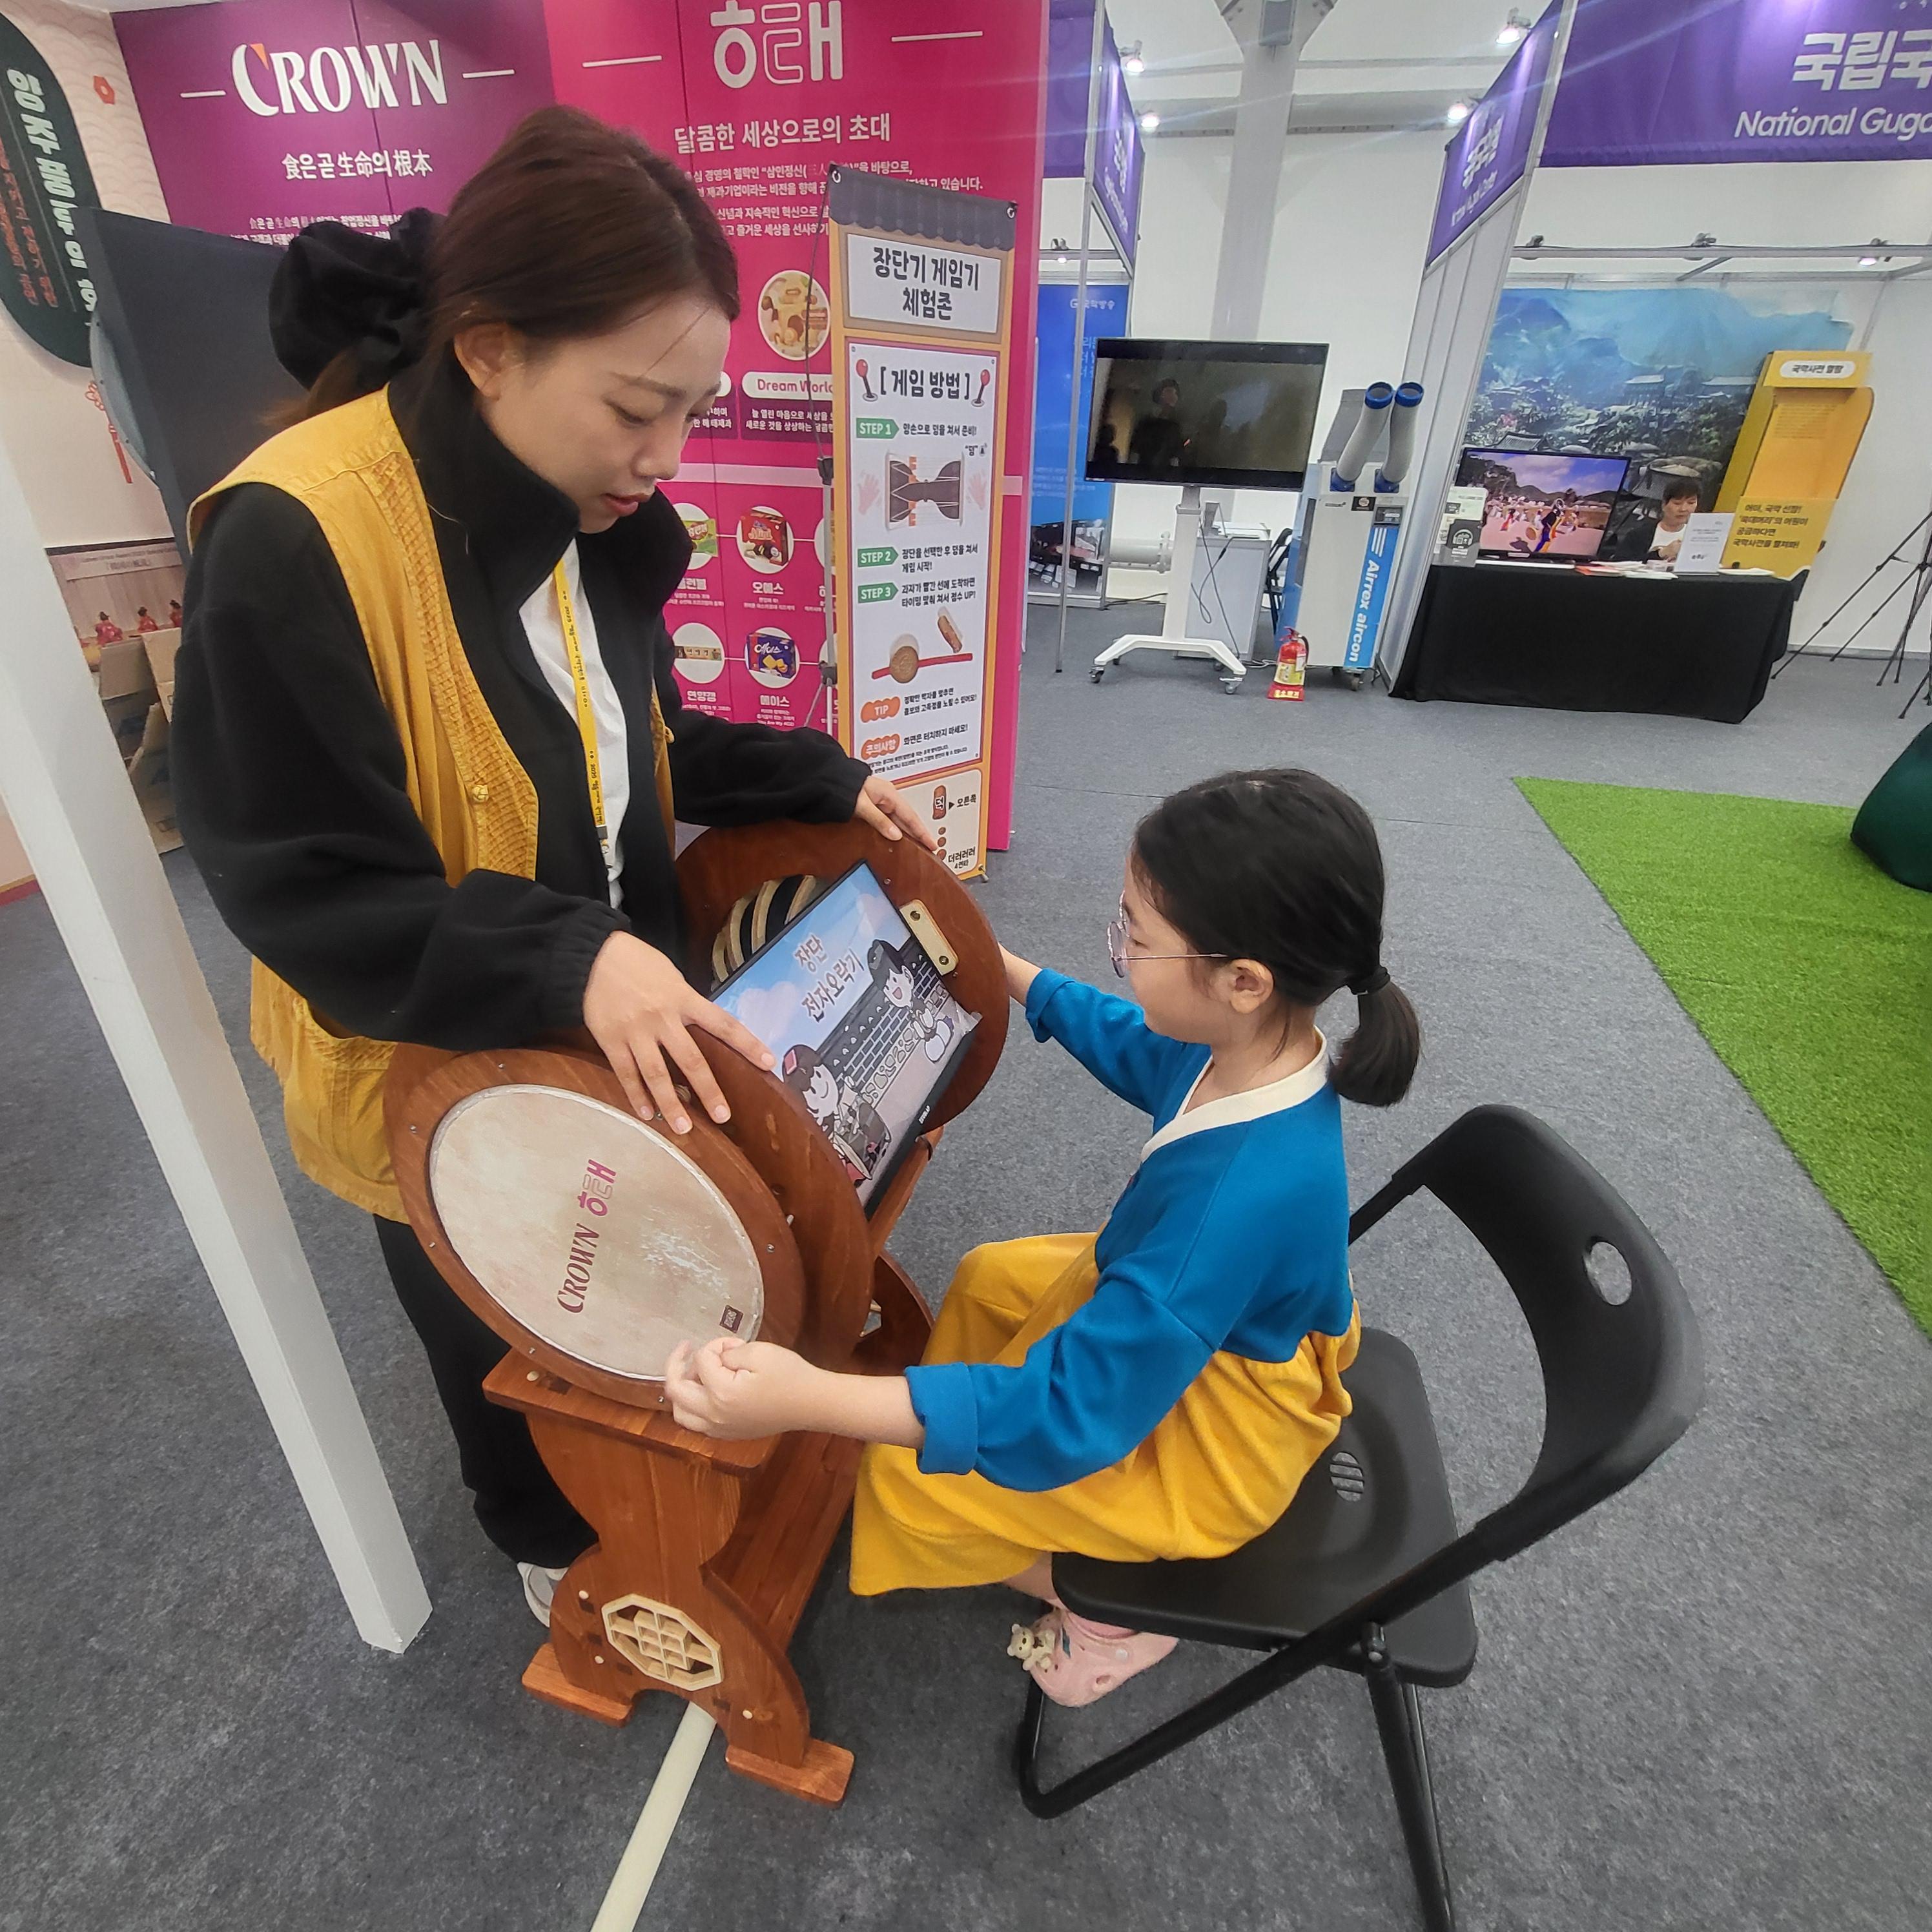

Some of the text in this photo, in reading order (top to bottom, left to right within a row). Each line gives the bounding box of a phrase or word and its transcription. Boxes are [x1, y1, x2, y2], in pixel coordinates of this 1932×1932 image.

[232, 39, 448, 117] CROWN
[674, 112, 890, 154] 달콤한 세상으로의 초대
[1734, 107, 1857, 138] National
[393, 149, 433, 178] 根本
[870, 161, 912, 175] 바탕으로,
[769, 182, 796, 197] 비전을
[940, 176, 983, 191] 있습니다.
[745, 206, 780, 220] 지속적인
[781, 205, 819, 219] 혁신으로
[874, 247, 979, 291] 장단기 게임기
[903, 287, 952, 321] 체험존
[757, 378, 798, 392] Dream
[891, 369, 924, 397] 게임
[929, 371, 960, 399] 방법
[859, 422, 892, 435] STEP 1
[860, 551, 892, 564] STEP 2
[861, 586, 891, 600] STEP 3
[1348, 559, 1380, 663] Airrex aircon
[874, 704, 889, 716] TIP
[866, 738, 896, 755] 주의사항
[948, 847, 976, 863] 더러러러
[793, 932, 828, 973] 장단
[801, 948, 865, 1023] 전자오락기
[557, 1222, 600, 1314] CROWN
